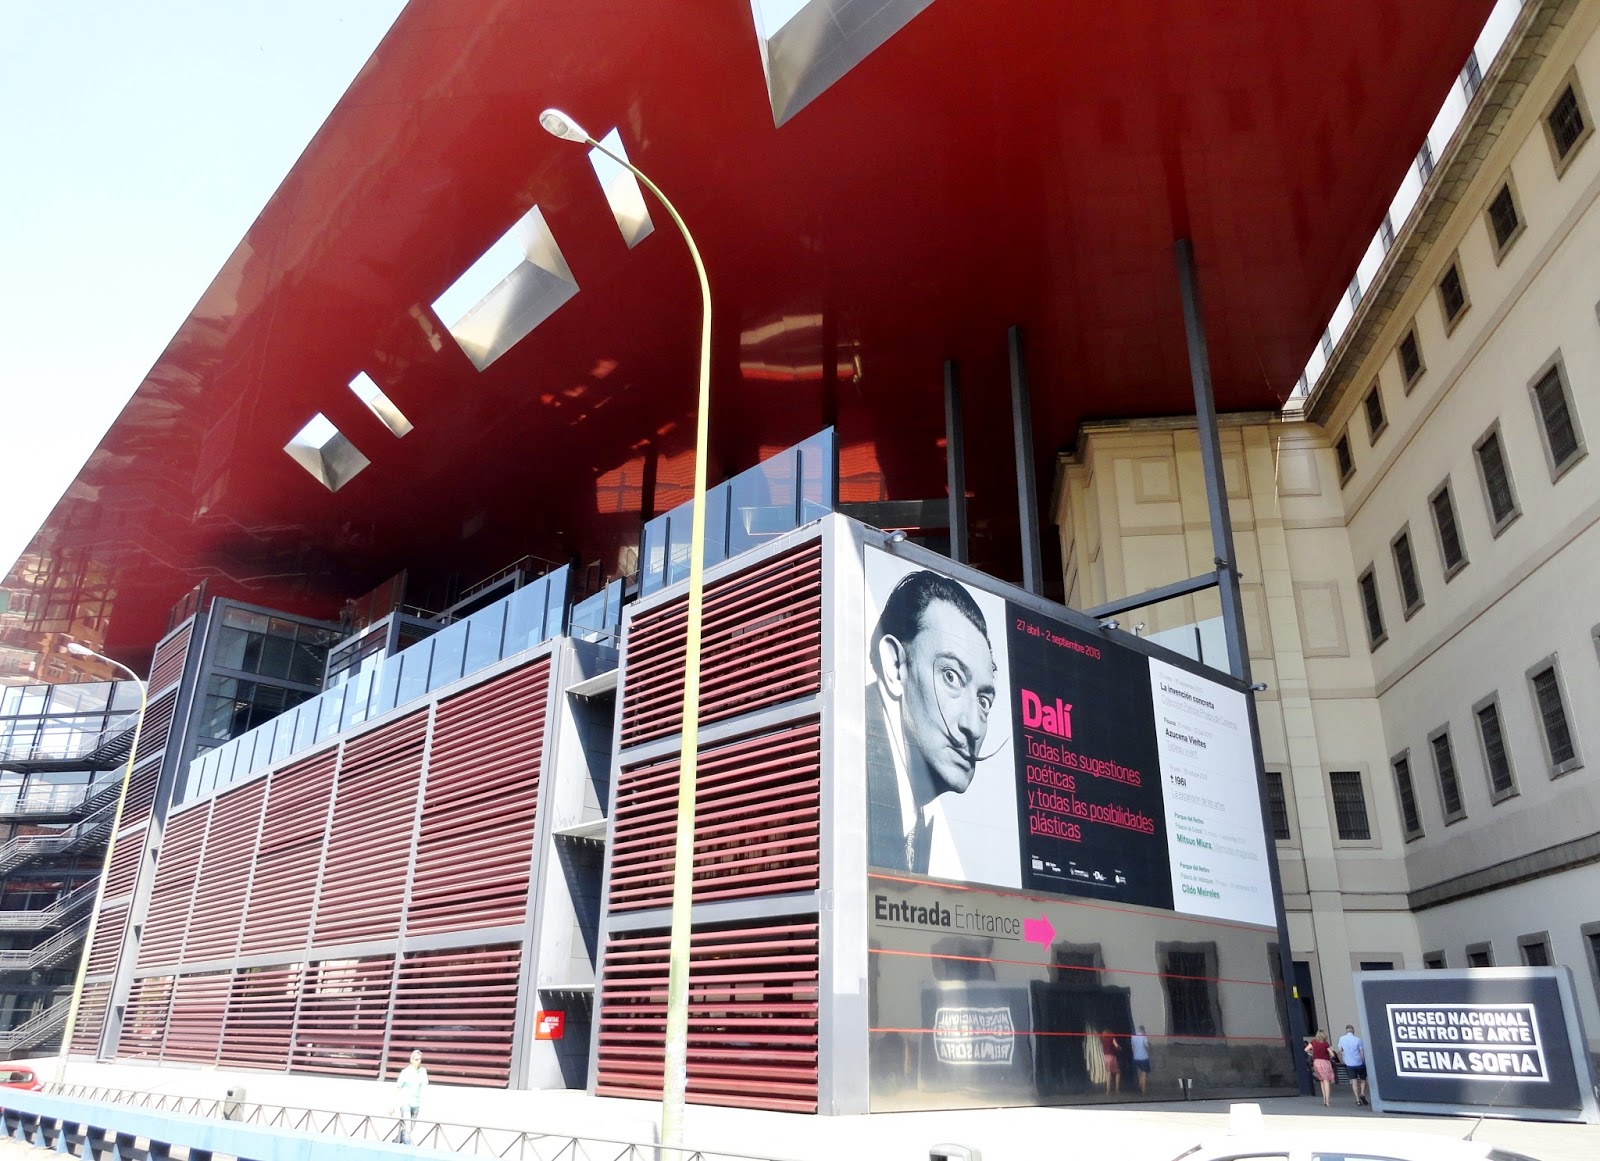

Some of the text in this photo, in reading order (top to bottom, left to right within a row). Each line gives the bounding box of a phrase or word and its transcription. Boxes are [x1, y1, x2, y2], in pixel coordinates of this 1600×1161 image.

[1016, 619, 1026, 631] 27
[1026, 624, 1040, 636] abril
[1046, 630, 1050, 641] 2
[1052, 635, 1084, 654] septiembre
[1085, 645, 1100, 660] 2013
[1160, 682, 1167, 692] La
[1168, 684, 1192, 701] invención
[1193, 696, 1215, 710] concreta
[1022, 688, 1072, 738] Dalí
[1166, 728, 1188, 742] Azucena
[1024, 734, 1060, 762] Todas
[1061, 744, 1078, 766] las
[1080, 755, 1141, 784] sugestiones
[1026, 764, 1076, 790] poéticas
[1028, 787, 1154, 832] y todas las posibilidades
[1030, 811, 1081, 839] plásticas
[1176, 833, 1196, 846] Mitsuo
[1182, 884, 1196, 894] Cildo
[874, 895, 1020, 934] Entrada Entrance
[1395, 1011, 1528, 1026] MUSEO NACIONAL
[1397, 1026, 1532, 1042] CENTRO DE ARTE
[1401, 1050, 1538, 1073] REINA SOFIA
